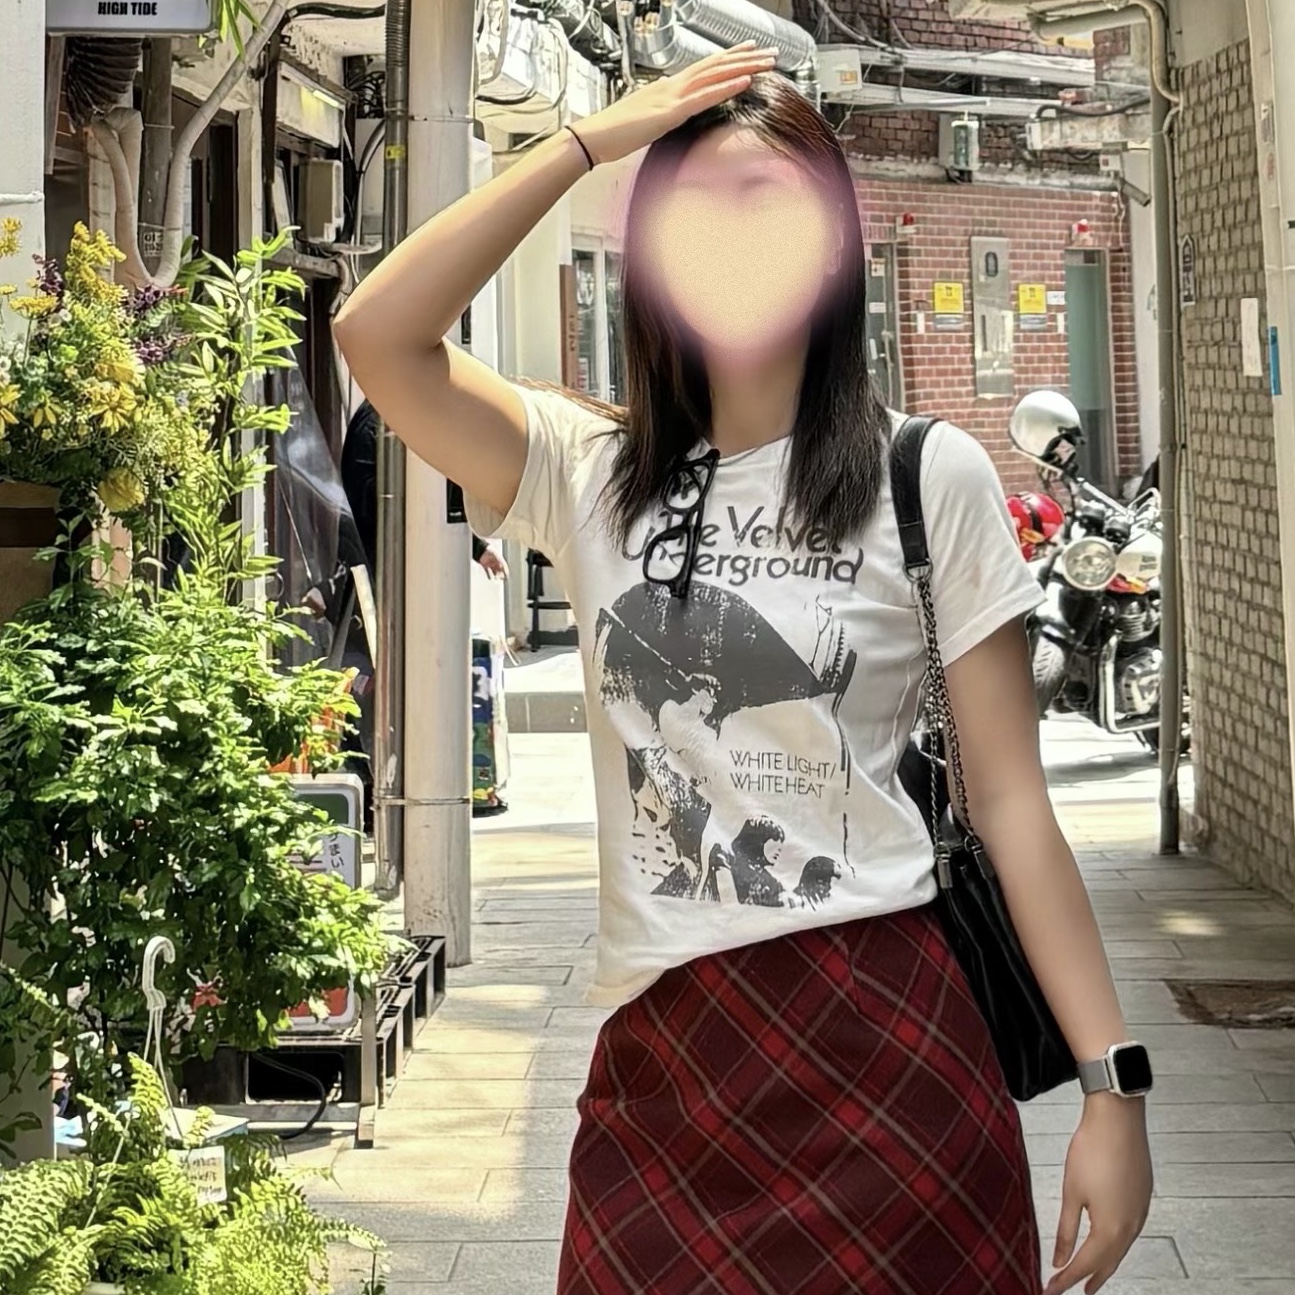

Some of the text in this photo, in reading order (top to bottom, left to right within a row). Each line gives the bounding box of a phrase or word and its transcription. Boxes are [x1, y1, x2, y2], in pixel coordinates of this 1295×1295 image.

[97, 1, 158, 16] HIGH TIDE
[730, 750, 784, 771] WHITE
[730, 772, 825, 800] WHITE HEAT
